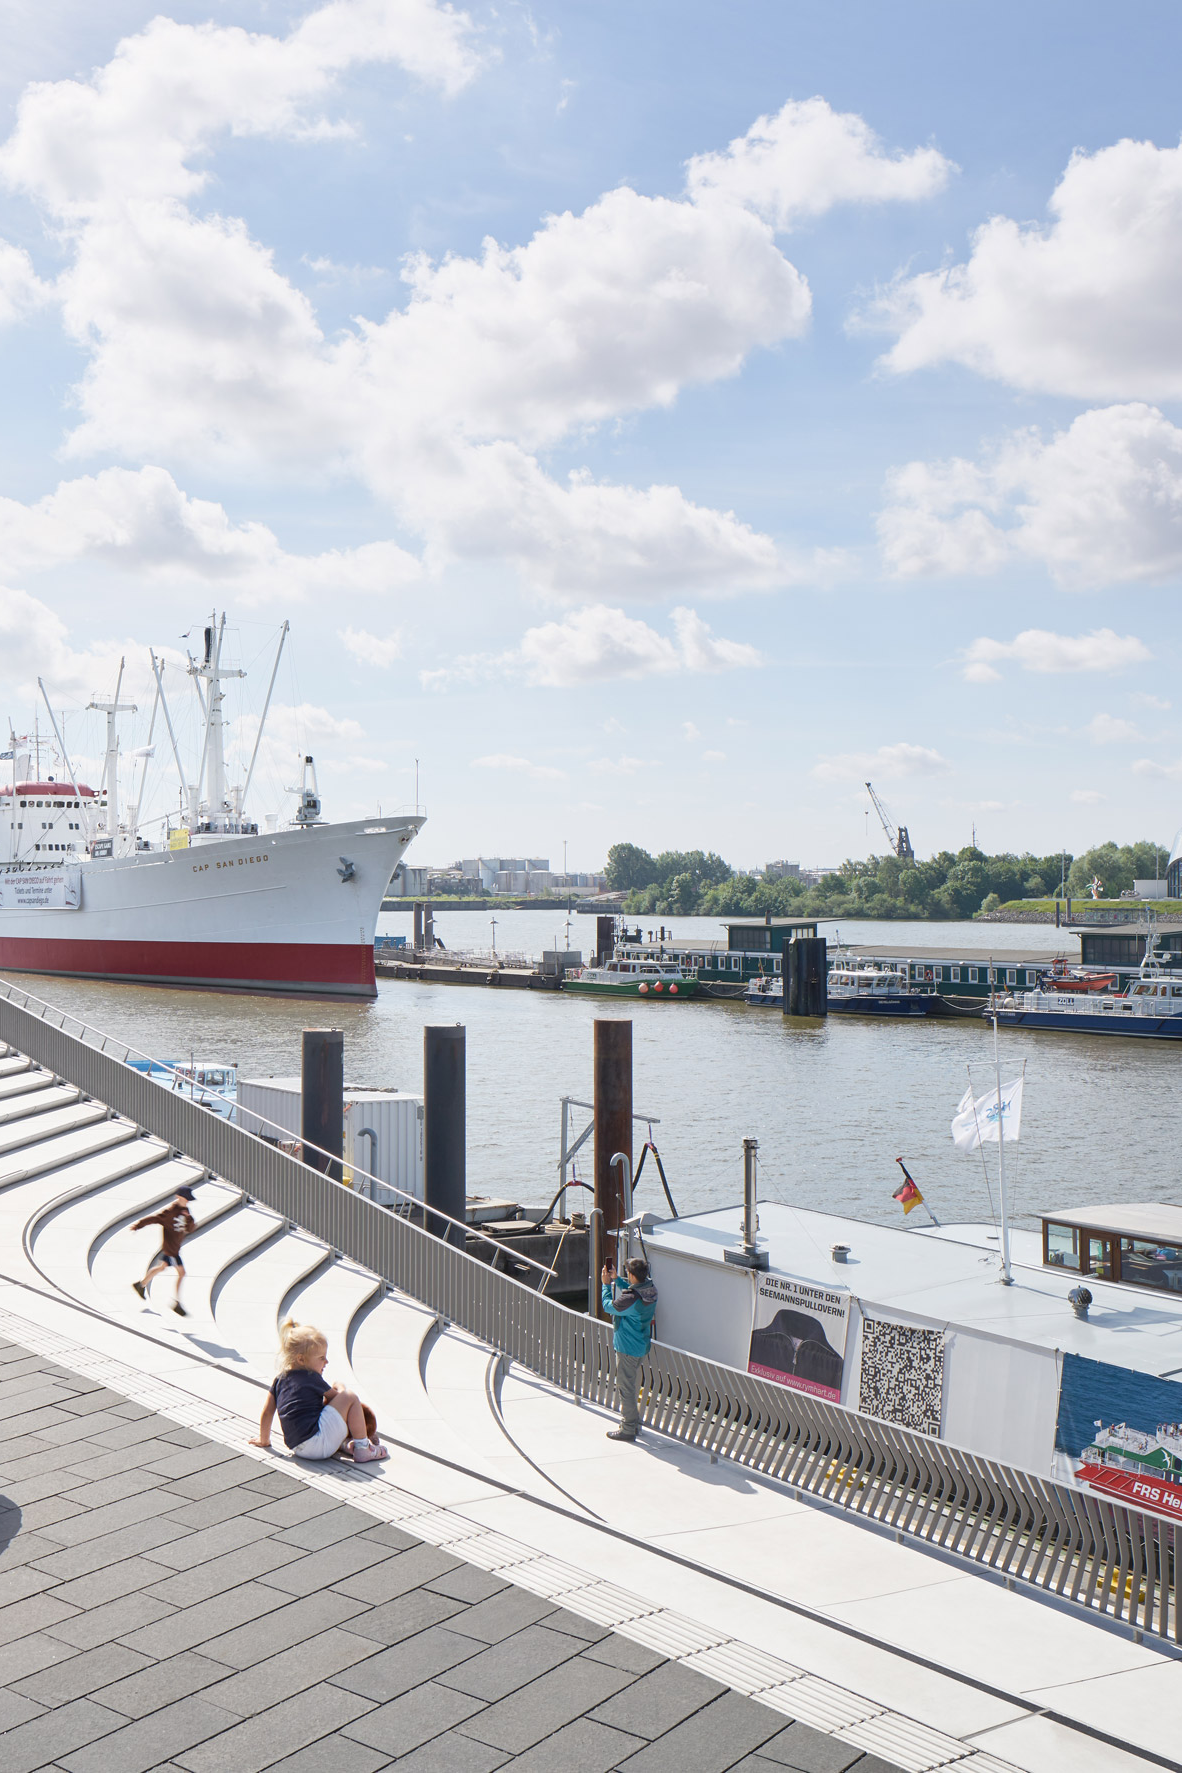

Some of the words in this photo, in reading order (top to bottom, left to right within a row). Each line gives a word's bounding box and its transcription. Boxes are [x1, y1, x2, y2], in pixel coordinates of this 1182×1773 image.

[192, 864, 209, 872] CAP
[216, 860, 234, 869] SAN
[238, 854, 269, 866] DIEGO
[1058, 997, 1074, 1006] ZOLL
[766, 1278, 778, 1288] DIE
[780, 1282, 792, 1292] NR.
[794, 1284, 798, 1293] 1
[799, 1286, 824, 1300] UNTER
[825, 1292, 841, 1304] DEN
[759, 1288, 845, 1318] SEEMANNSPULLOVERN!
[750, 1365, 775, 1379] Exklusiv
[775, 1374, 786, 1383] auf
[786, 1377, 836, 1400] www.rymhart.de
[1132, 1481, 1160, 1500] FRS
